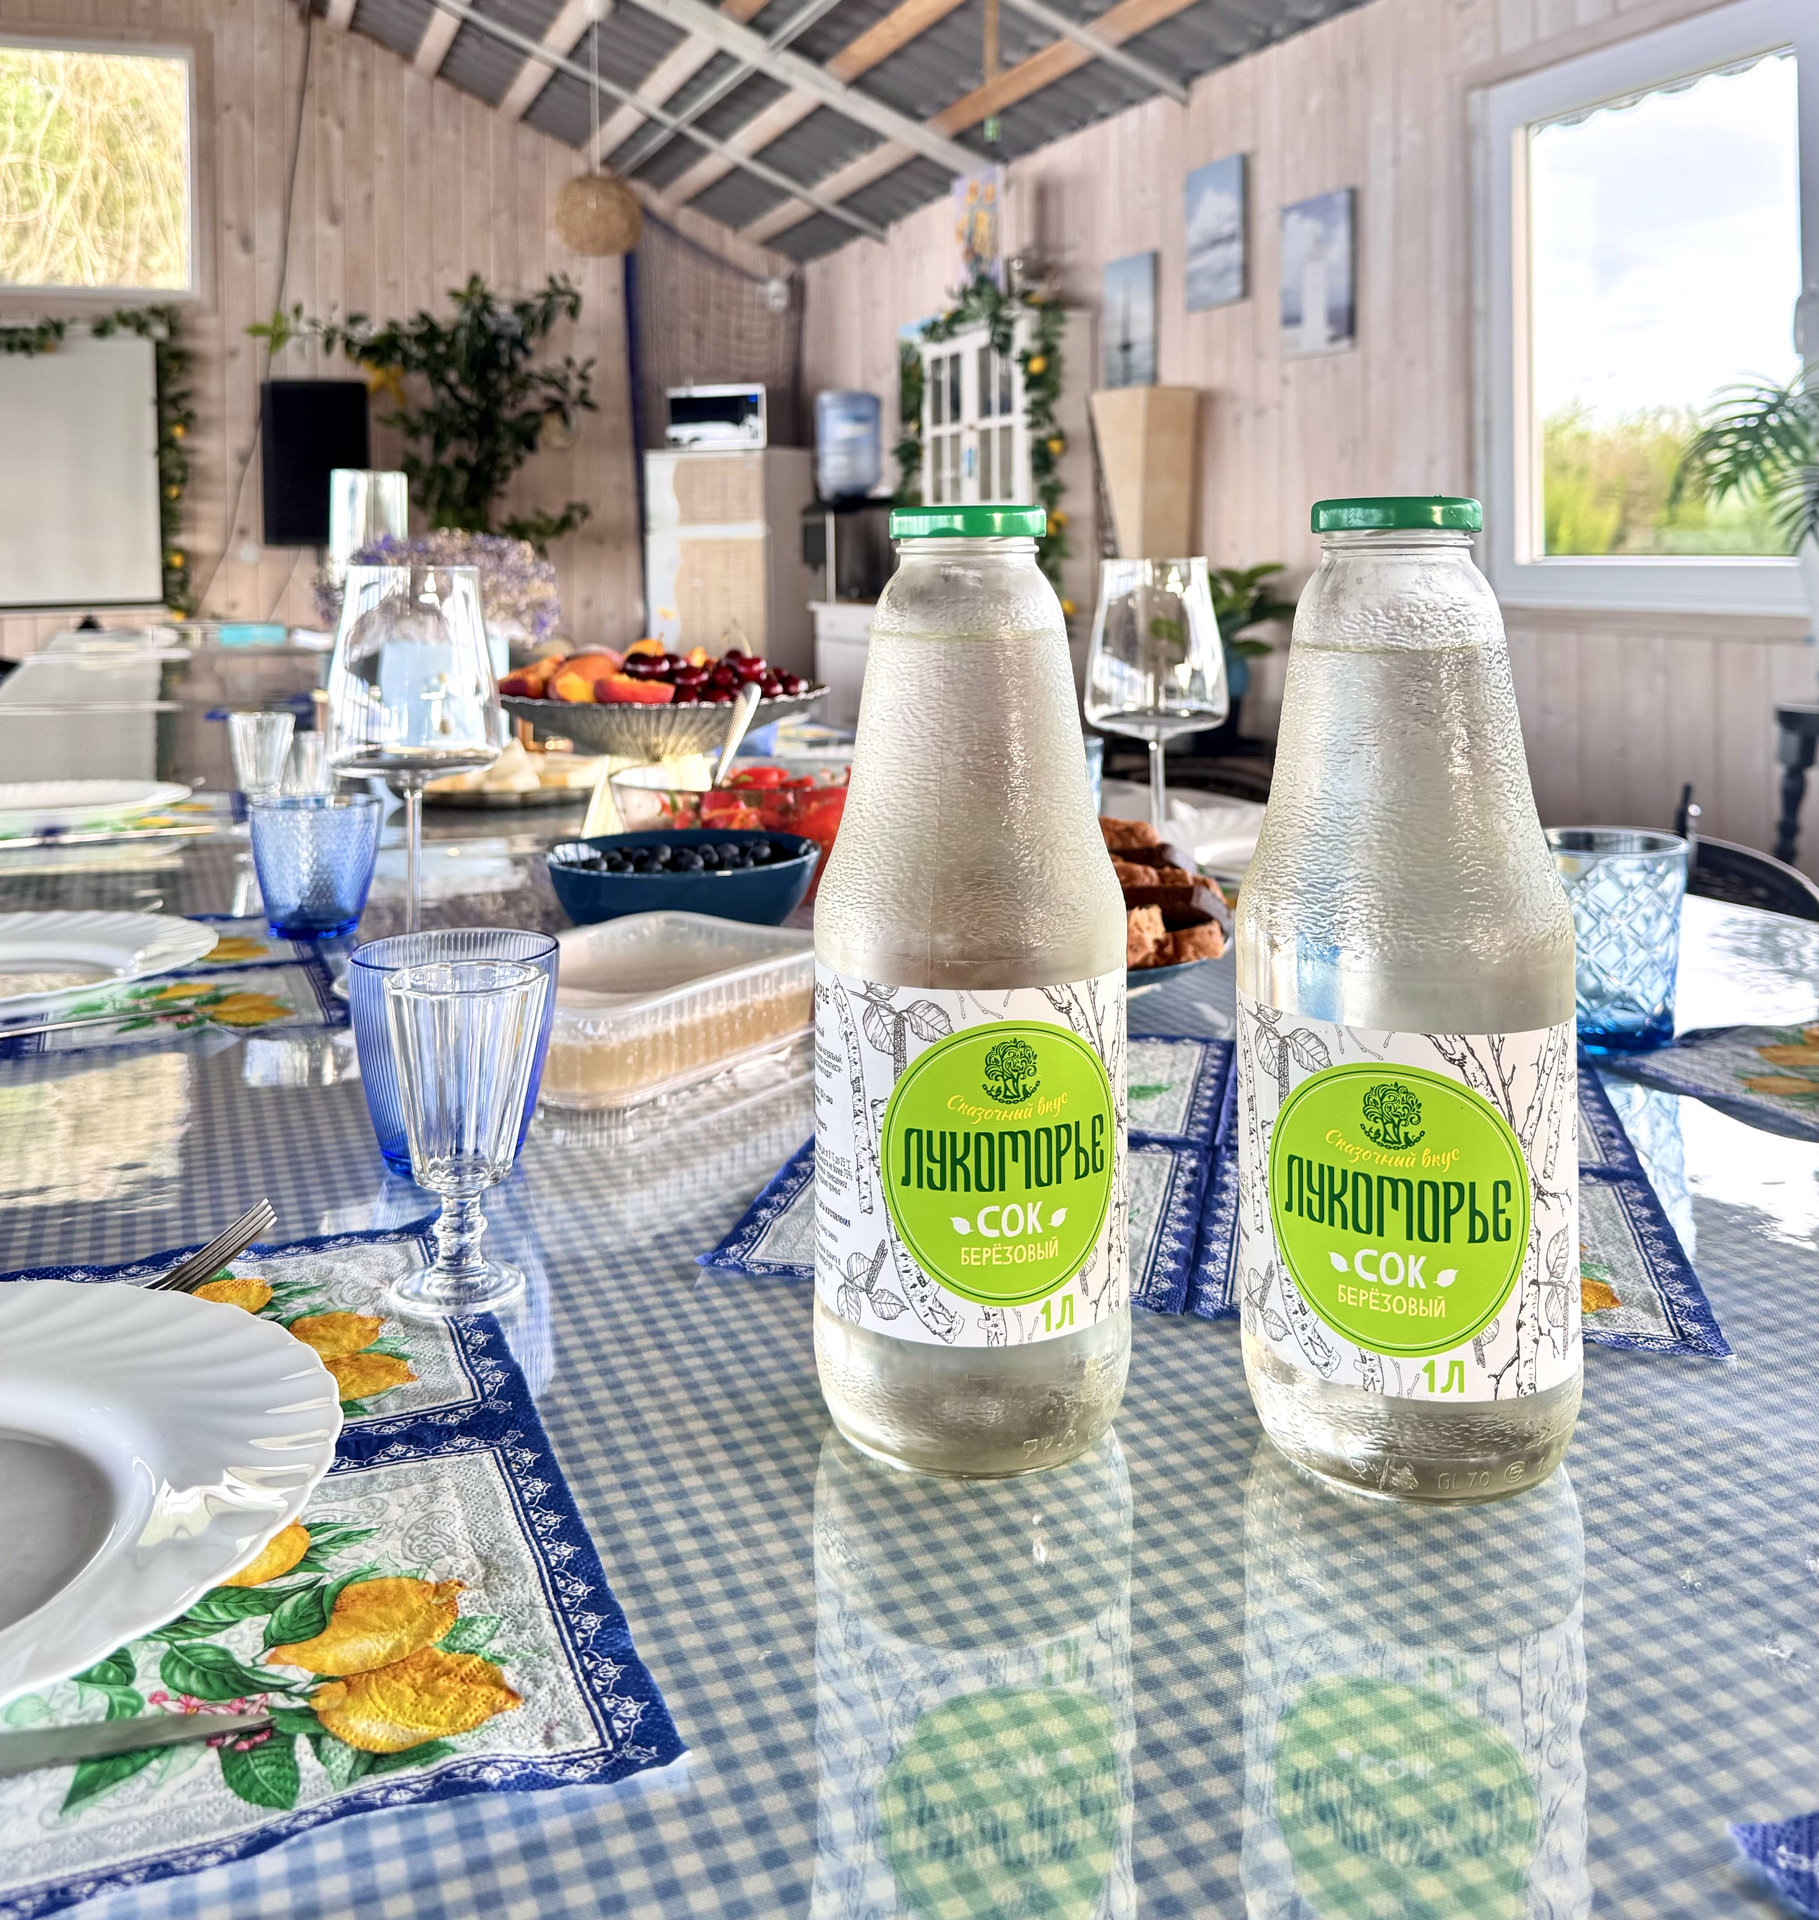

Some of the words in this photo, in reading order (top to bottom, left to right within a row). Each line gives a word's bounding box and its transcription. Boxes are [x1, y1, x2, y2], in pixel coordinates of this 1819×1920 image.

[947, 1094, 1032, 1125] Сказочный
[1037, 1092, 1068, 1118] вкус
[901, 1113, 1104, 1193] ЛУКОМОРЬЕ
[1325, 1128, 1416, 1168] Сказочный
[1421, 1147, 1460, 1172] вкус
[1284, 1153, 1512, 1244] ЛУКОМОРЬЕ
[977, 1201, 1043, 1238] СОК
[961, 1236, 1059, 1266] БЕРЁЗОВЫЙ
[1353, 1248, 1427, 1289] СОК
[1337, 1284, 1446, 1319] БЕРЁЗОВЫЙ
[1467, 1470, 1490, 1489] 70
